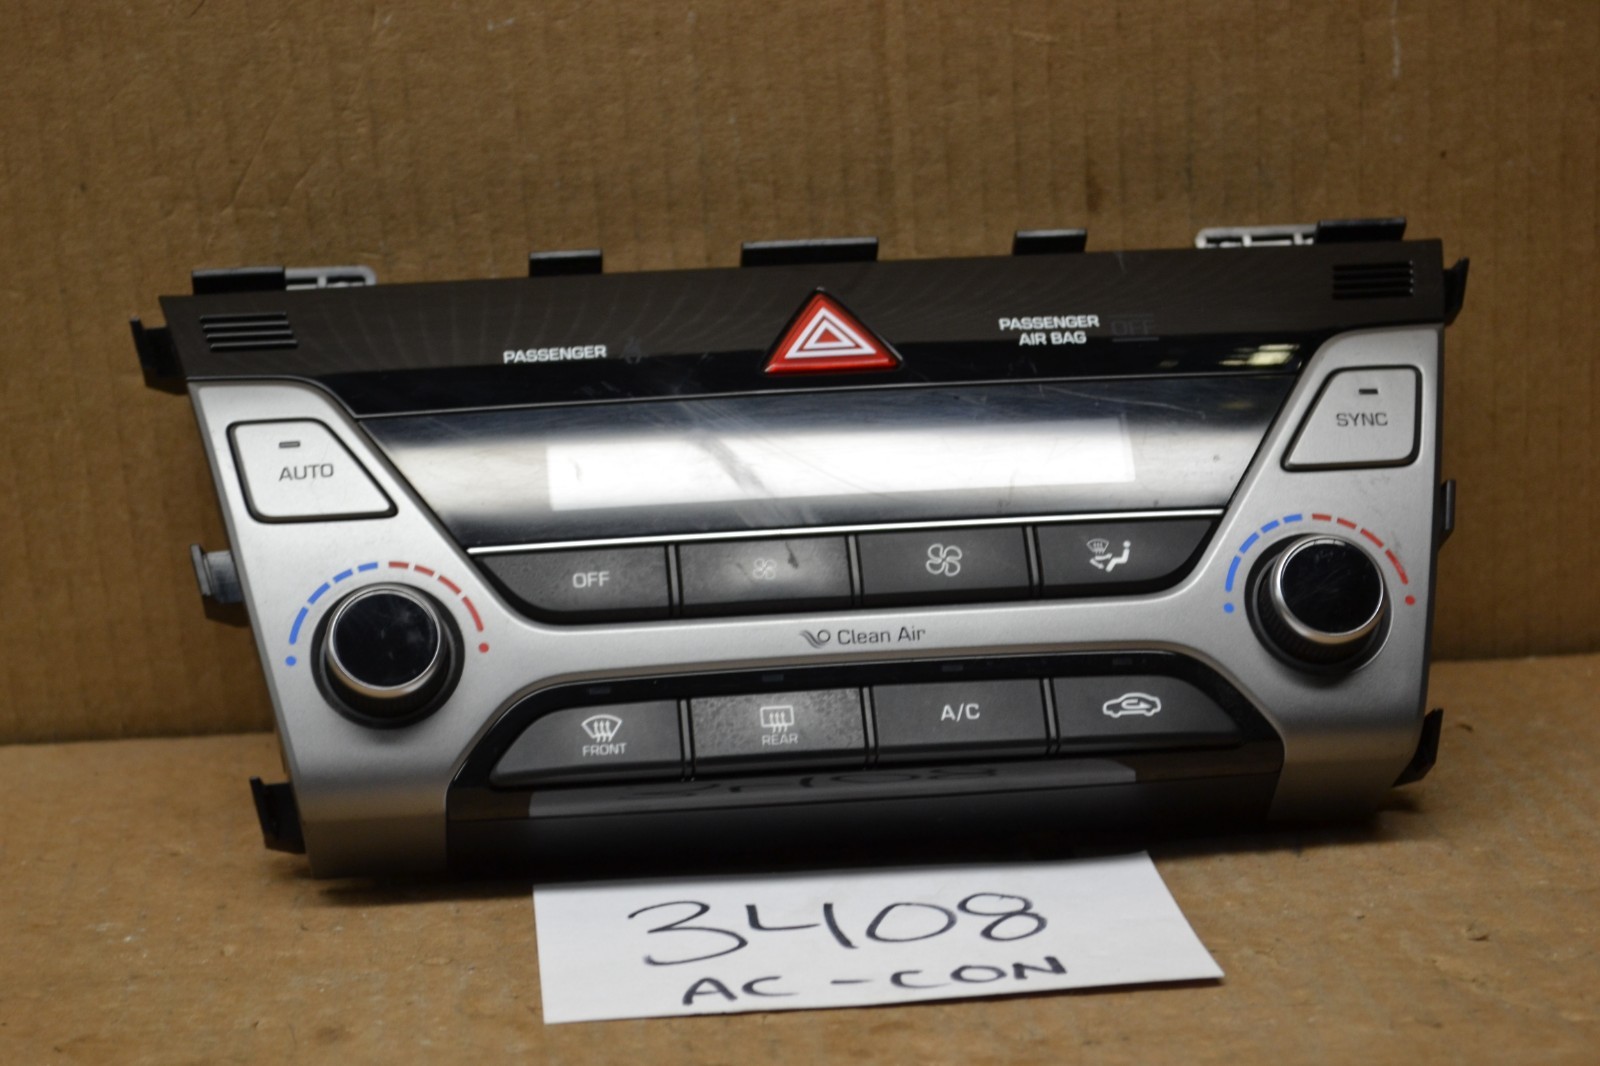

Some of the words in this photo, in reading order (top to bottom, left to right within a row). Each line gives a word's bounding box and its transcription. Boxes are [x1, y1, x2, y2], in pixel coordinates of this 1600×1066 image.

[998, 314, 1100, 331] PASSENGER
[1018, 331, 1047, 346] AIR
[1050, 330, 1087, 345] BAG
[502, 344, 608, 365] PASSENGER
[1335, 412, 1389, 428] SYNC
[278, 463, 335, 482] AUTO
[571, 570, 611, 590] OFF
[837, 628, 891, 646] Clean
[897, 625, 926, 642] Air
[939, 702, 982, 722] A/C
[761, 731, 799, 747] REAR
[581, 741, 627, 758] FRONT
[627, 891, 1048, 967] 3408
